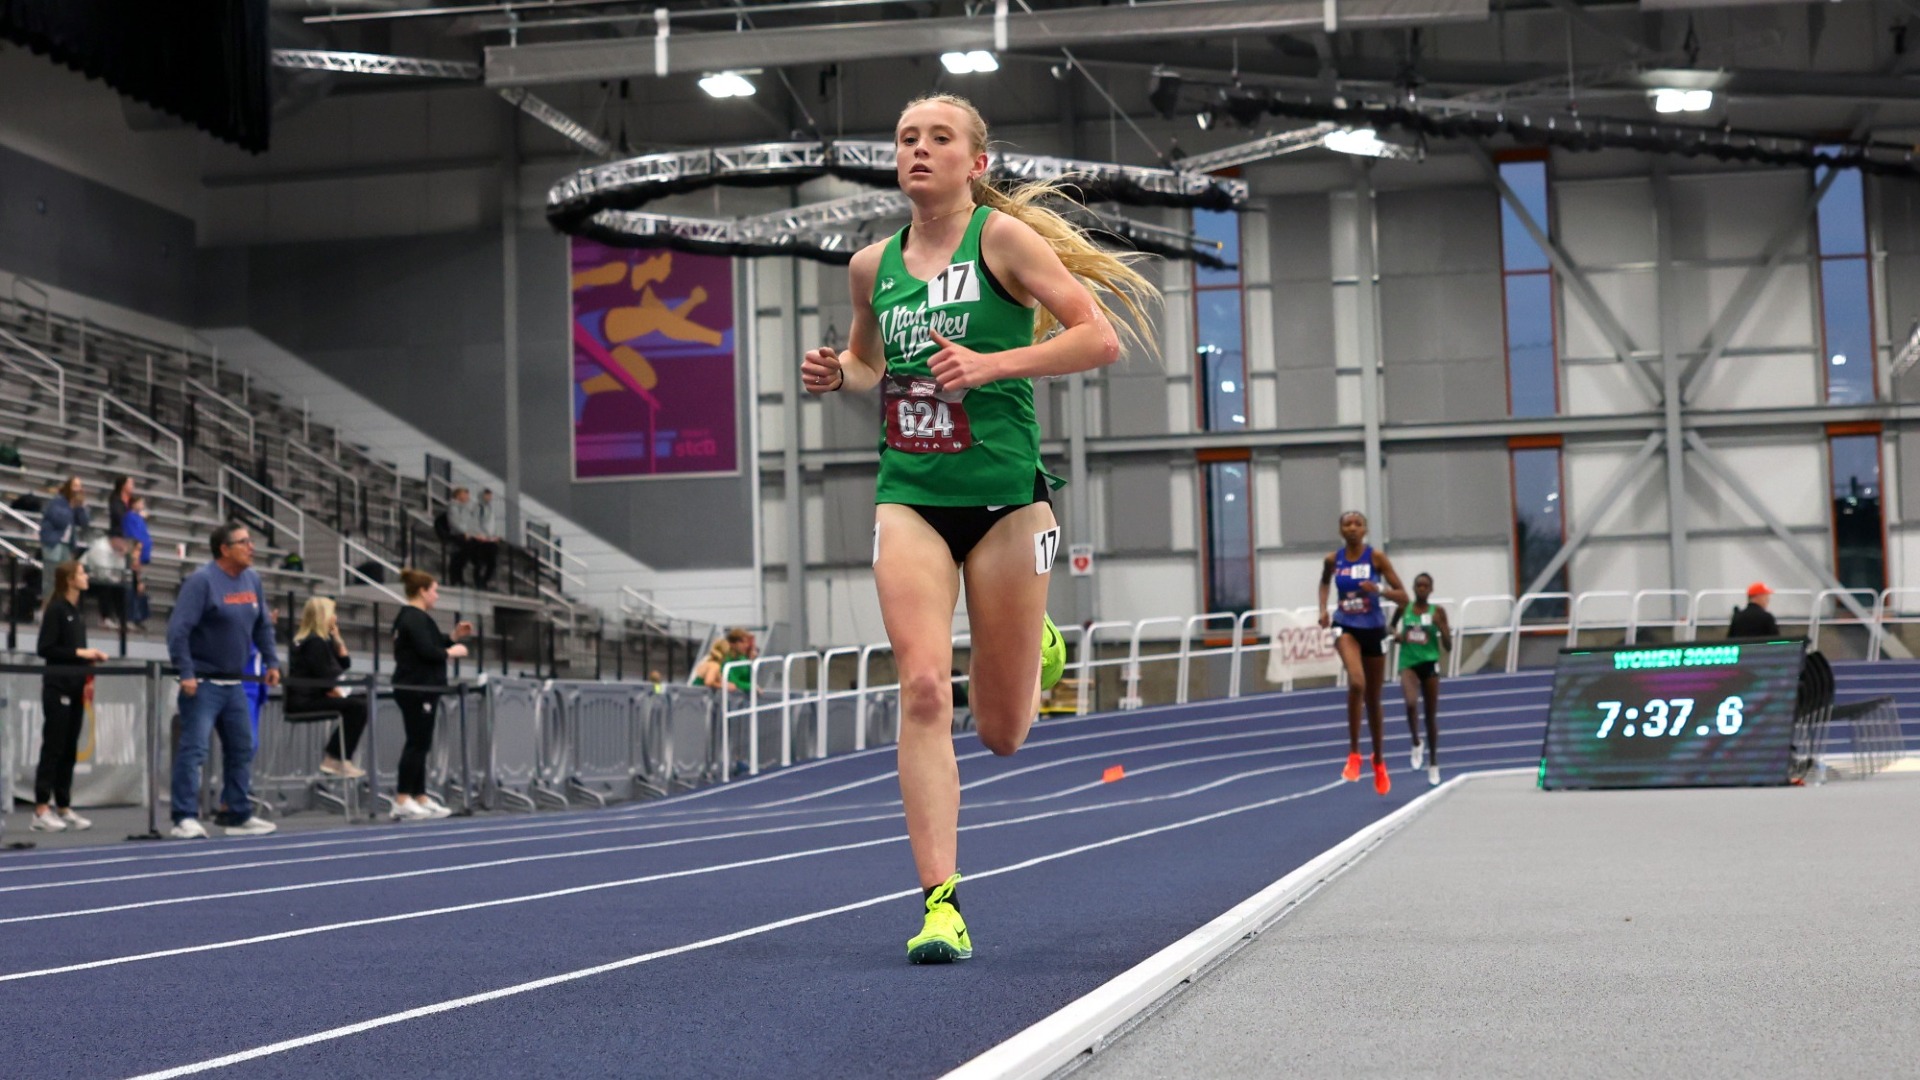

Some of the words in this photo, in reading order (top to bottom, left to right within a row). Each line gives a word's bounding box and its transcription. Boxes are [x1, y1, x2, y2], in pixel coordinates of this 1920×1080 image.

[936, 263, 970, 302] 17
[879, 301, 929, 345] Utah
[893, 310, 970, 363] Valley
[897, 399, 954, 438] 624
[1040, 530, 1057, 569] 17
[1614, 649, 1682, 669] WOMEN
[1596, 696, 1744, 738] 7:37.6
